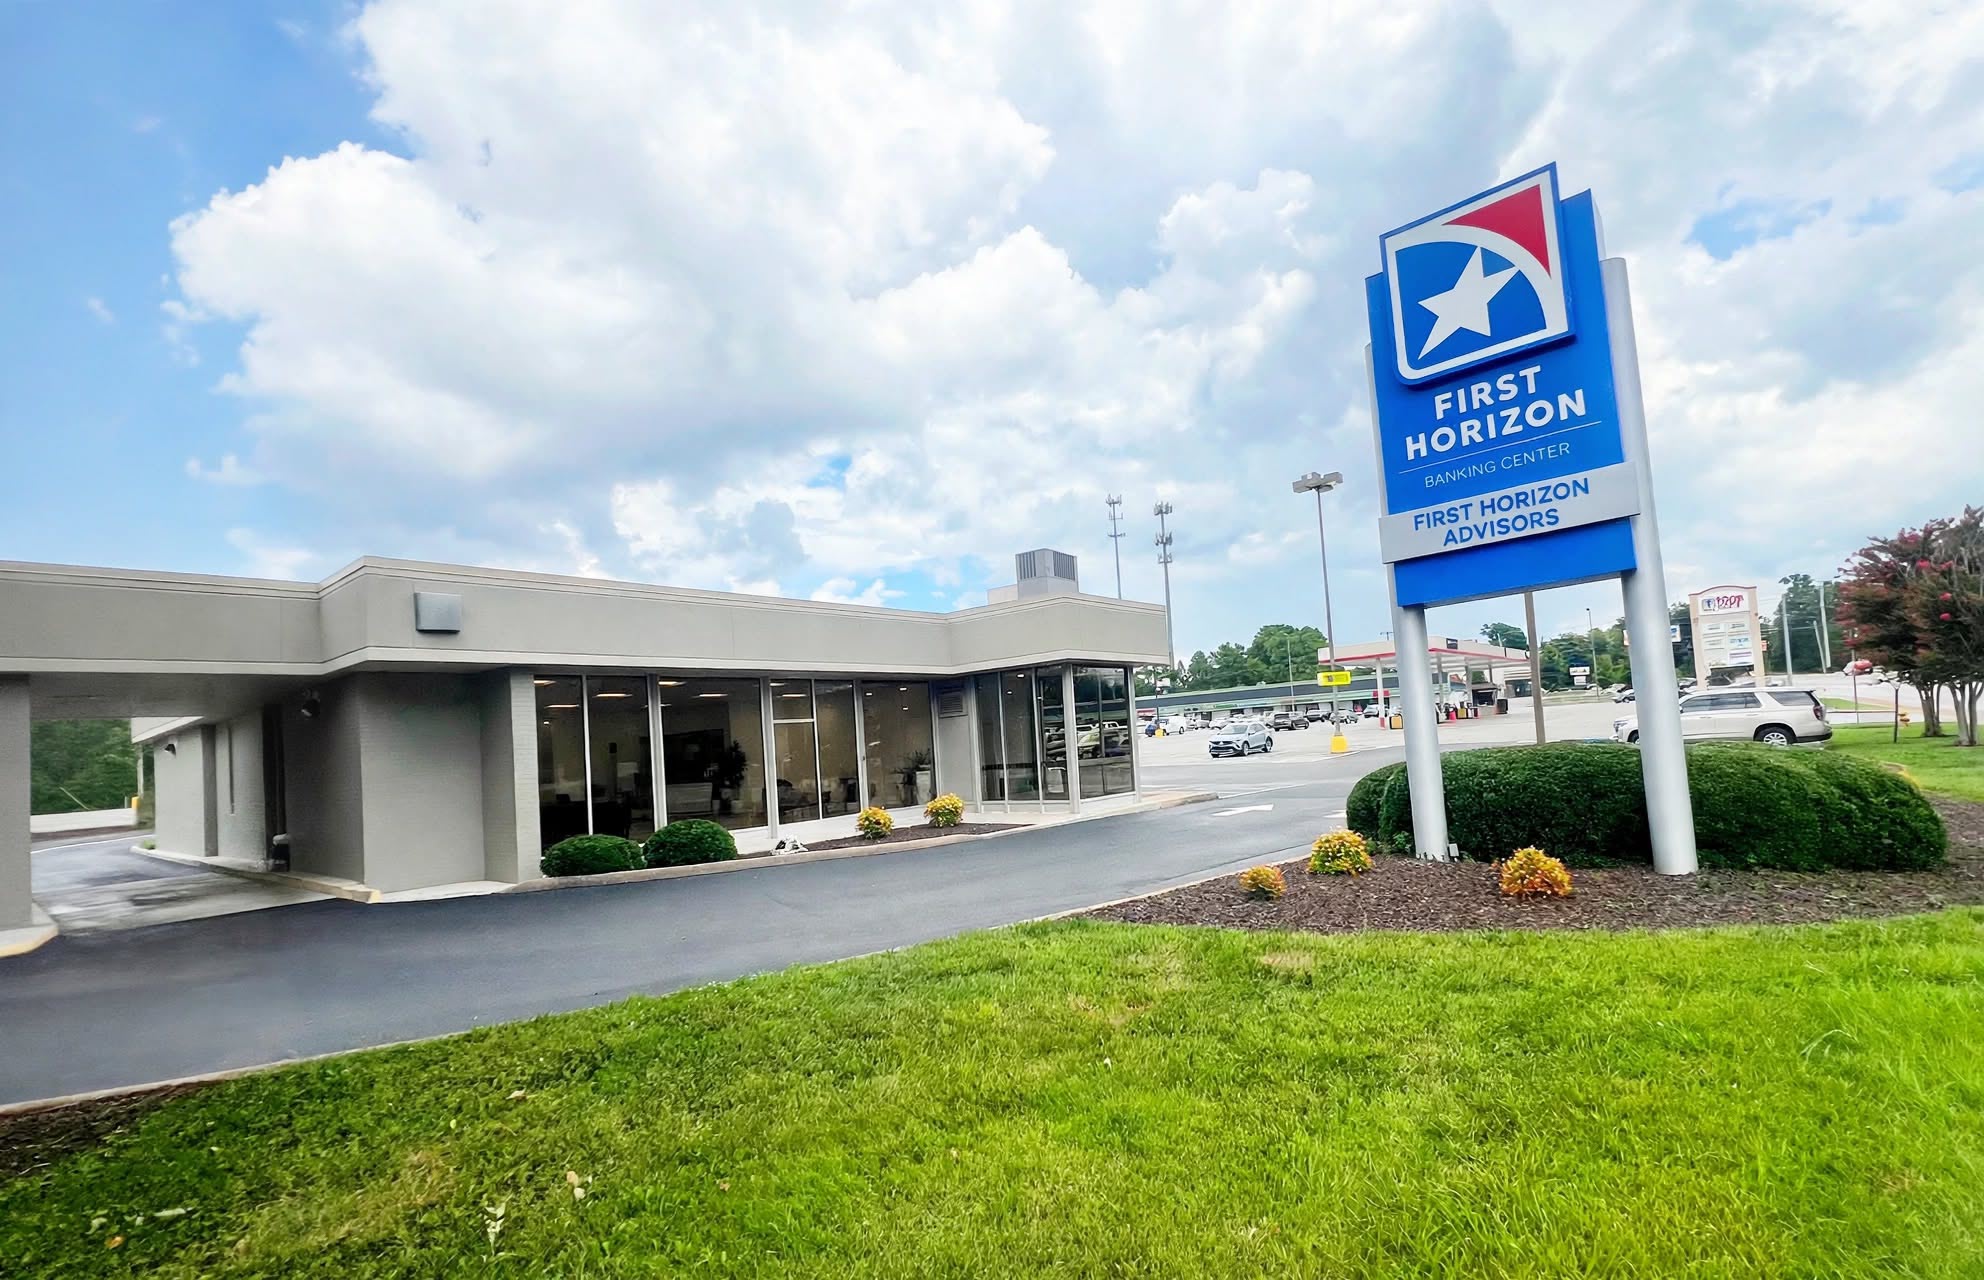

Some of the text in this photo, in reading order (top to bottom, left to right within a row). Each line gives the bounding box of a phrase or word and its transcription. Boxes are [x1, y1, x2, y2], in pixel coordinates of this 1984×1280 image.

[1435, 366, 1541, 419] FIRST
[1406, 389, 1586, 460] HORIZON
[1425, 443, 1570, 488] BANKING CENTER
[1414, 478, 1590, 531] FIRST HORIZON
[1443, 508, 1560, 546] ADVISORS
